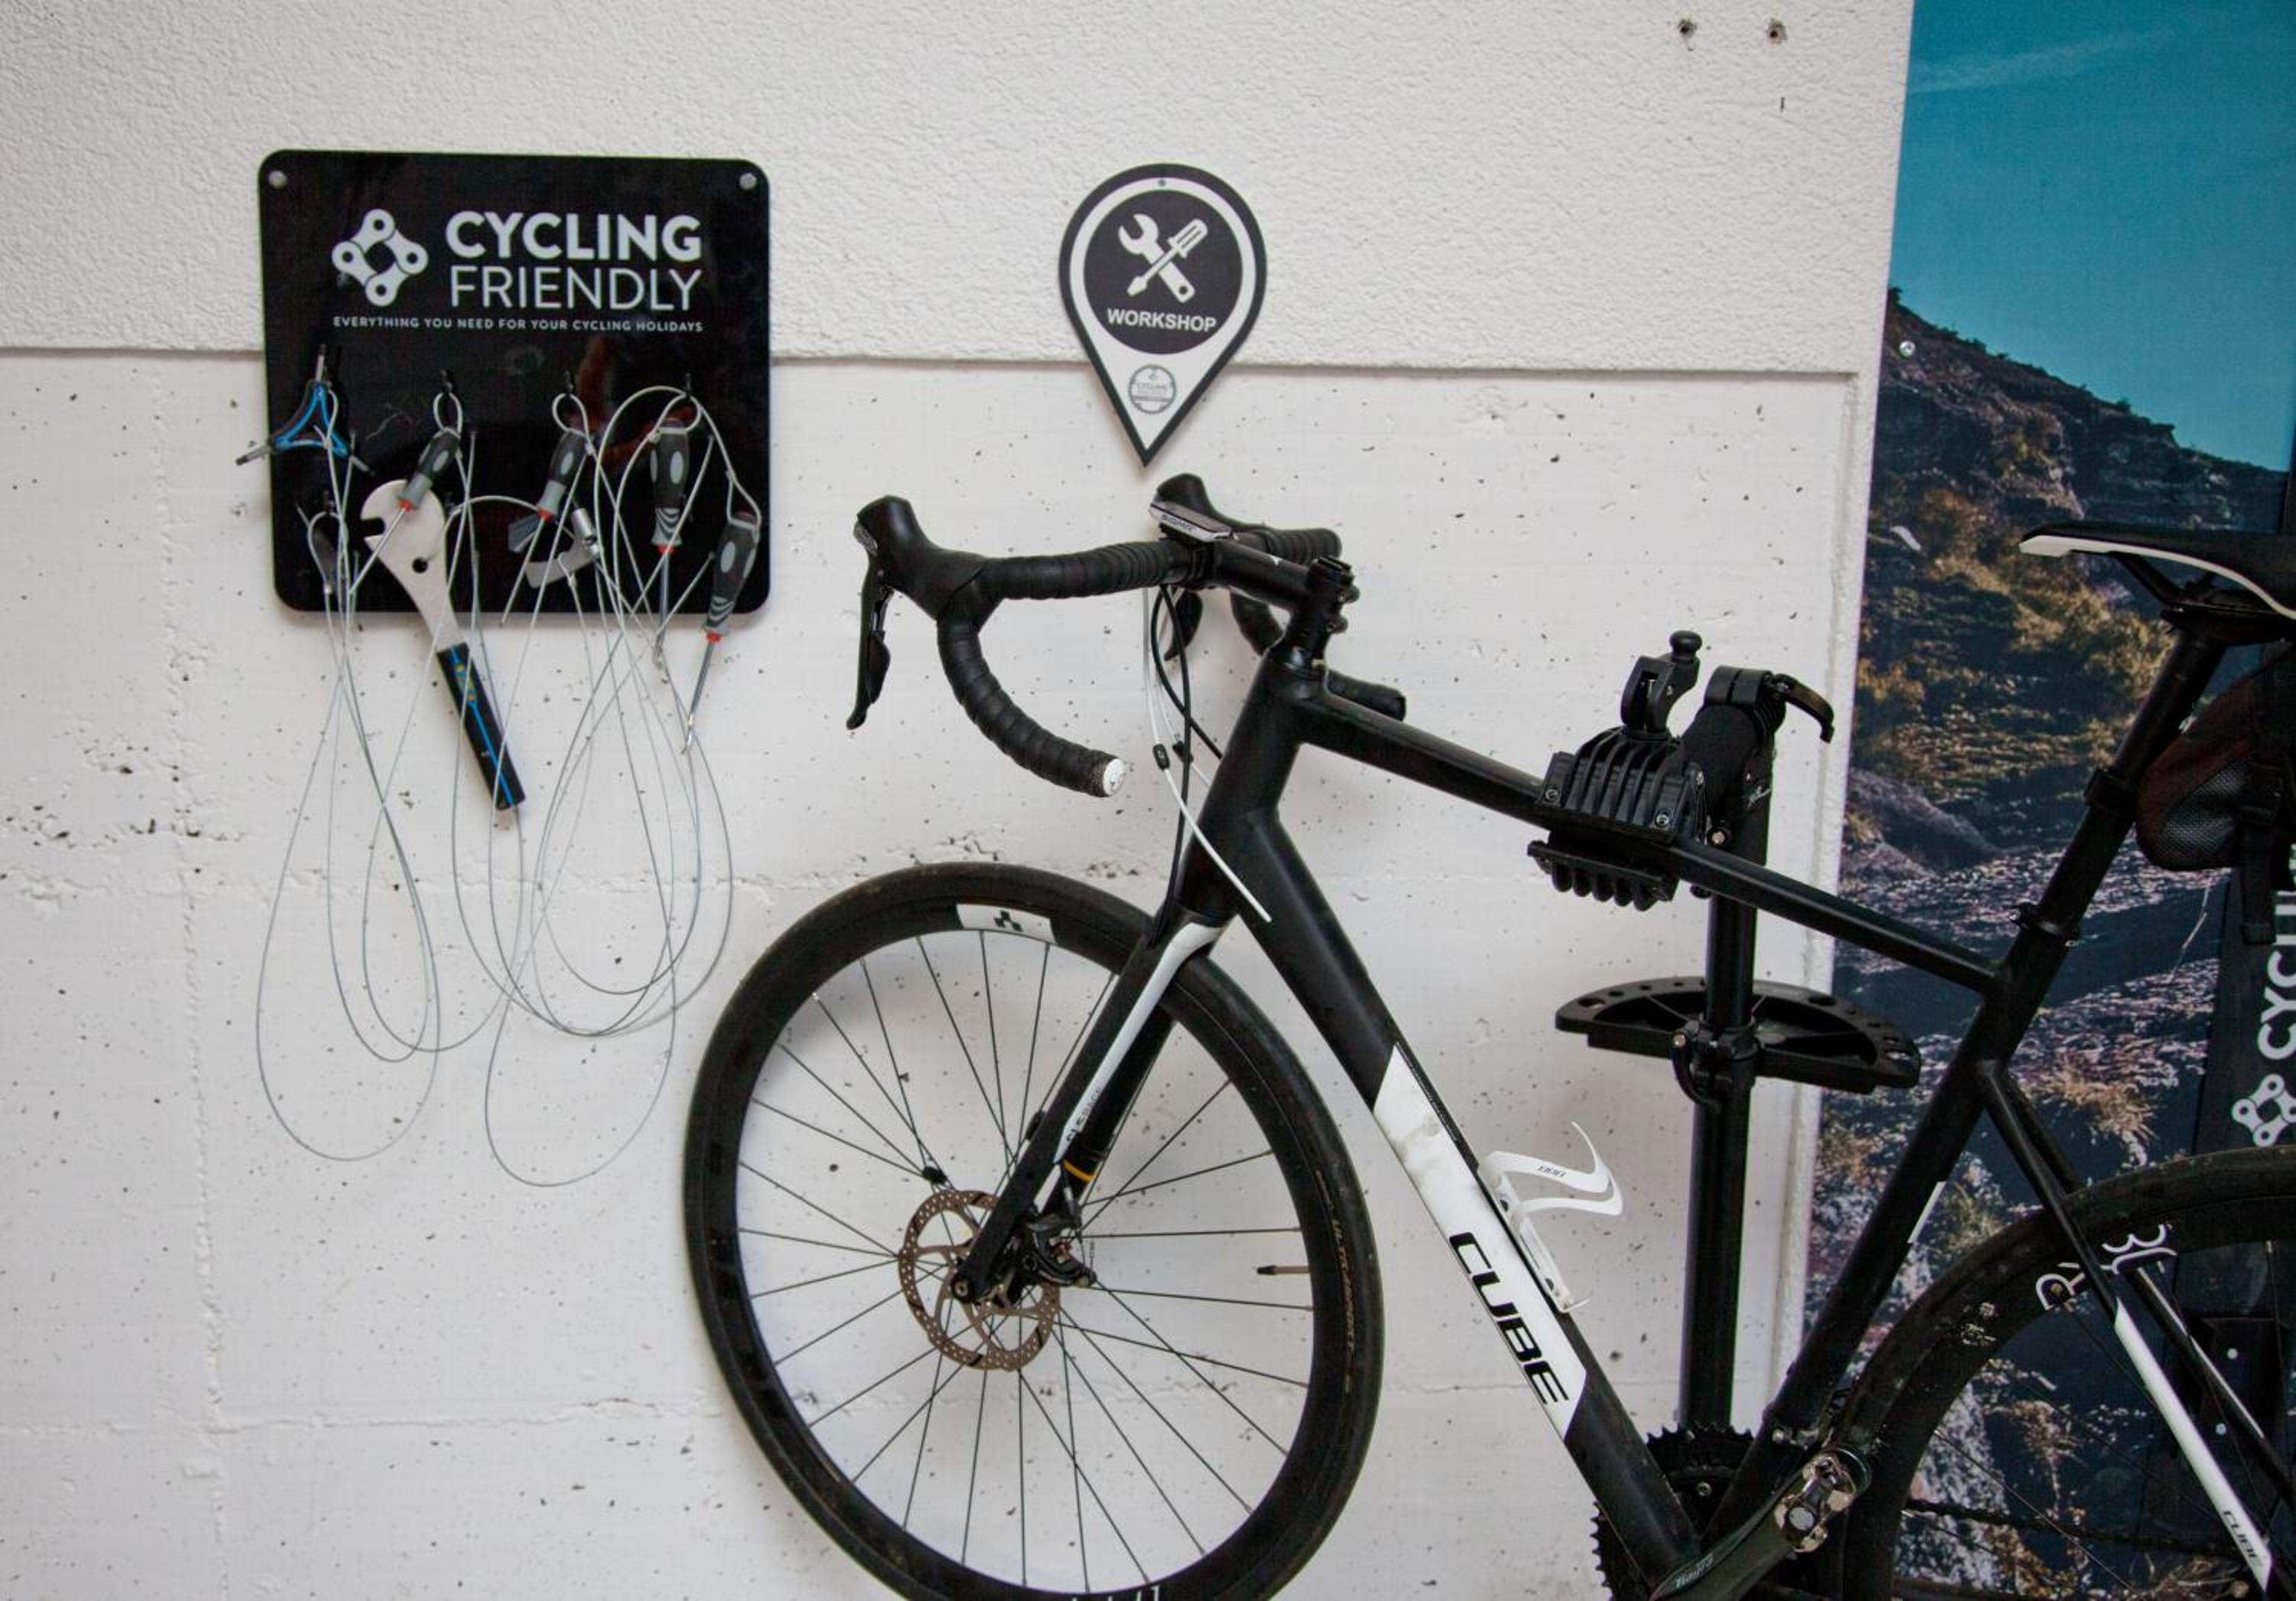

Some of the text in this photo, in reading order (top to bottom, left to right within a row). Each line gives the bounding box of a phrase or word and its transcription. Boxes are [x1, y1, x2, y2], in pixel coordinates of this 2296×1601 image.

[445, 210, 702, 262] CYCLING
[451, 265, 702, 311] FRIENDLY
[333, 316, 703, 332] EVERYTHING YOU NEED FOR YOUR CYCLING HOLIDAYS
[1107, 308, 1217, 332] WORKSHOP
[1449, 1231, 1569, 1404] CUBE
